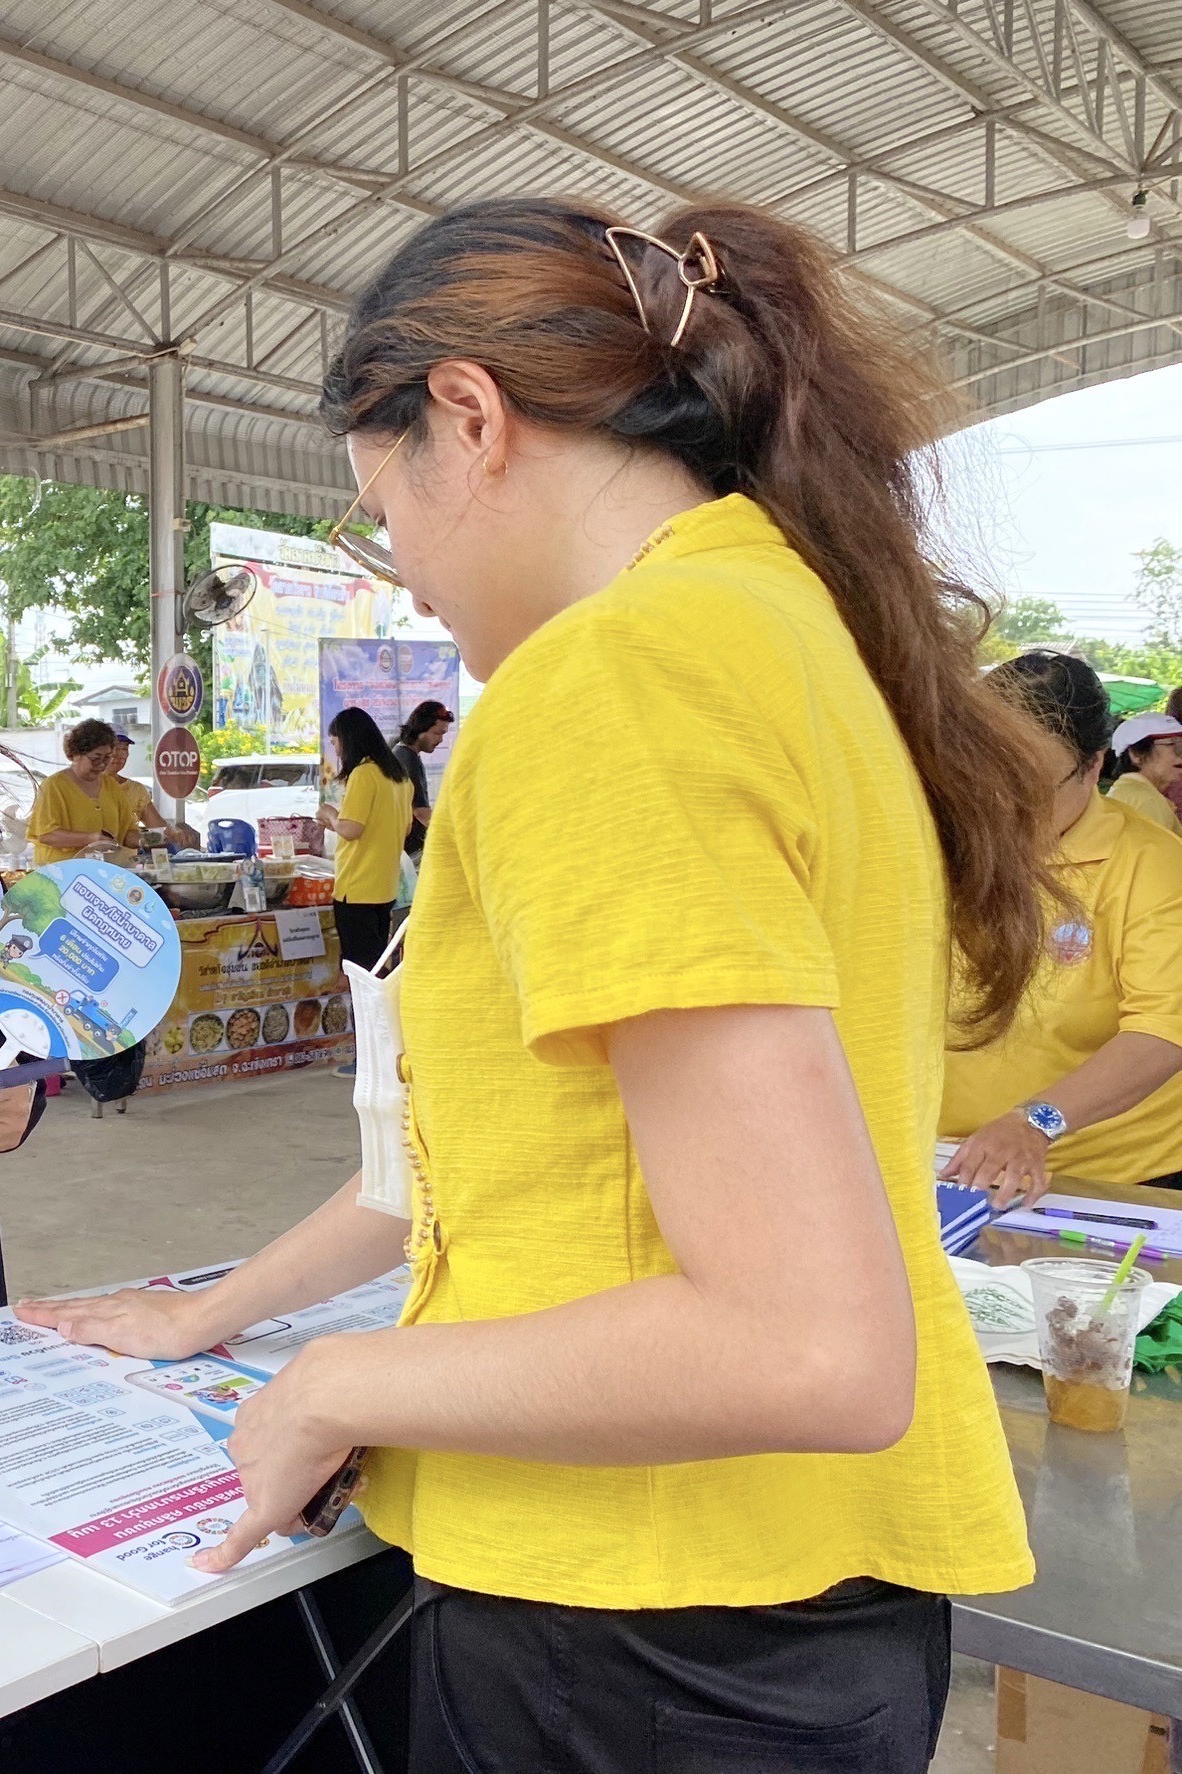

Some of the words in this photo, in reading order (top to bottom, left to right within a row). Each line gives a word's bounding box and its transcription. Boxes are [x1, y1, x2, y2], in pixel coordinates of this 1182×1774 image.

[159, 751, 198, 767] OTOP
[81, 906, 132, 949] ผิดกฎหมาย
[100, 1516, 123, 1529] 13
[113, 1507, 184, 1538] คลิกชุมชน
[67, 1523, 99, 1539] เมนู
[116, 1546, 149, 1562] Good
